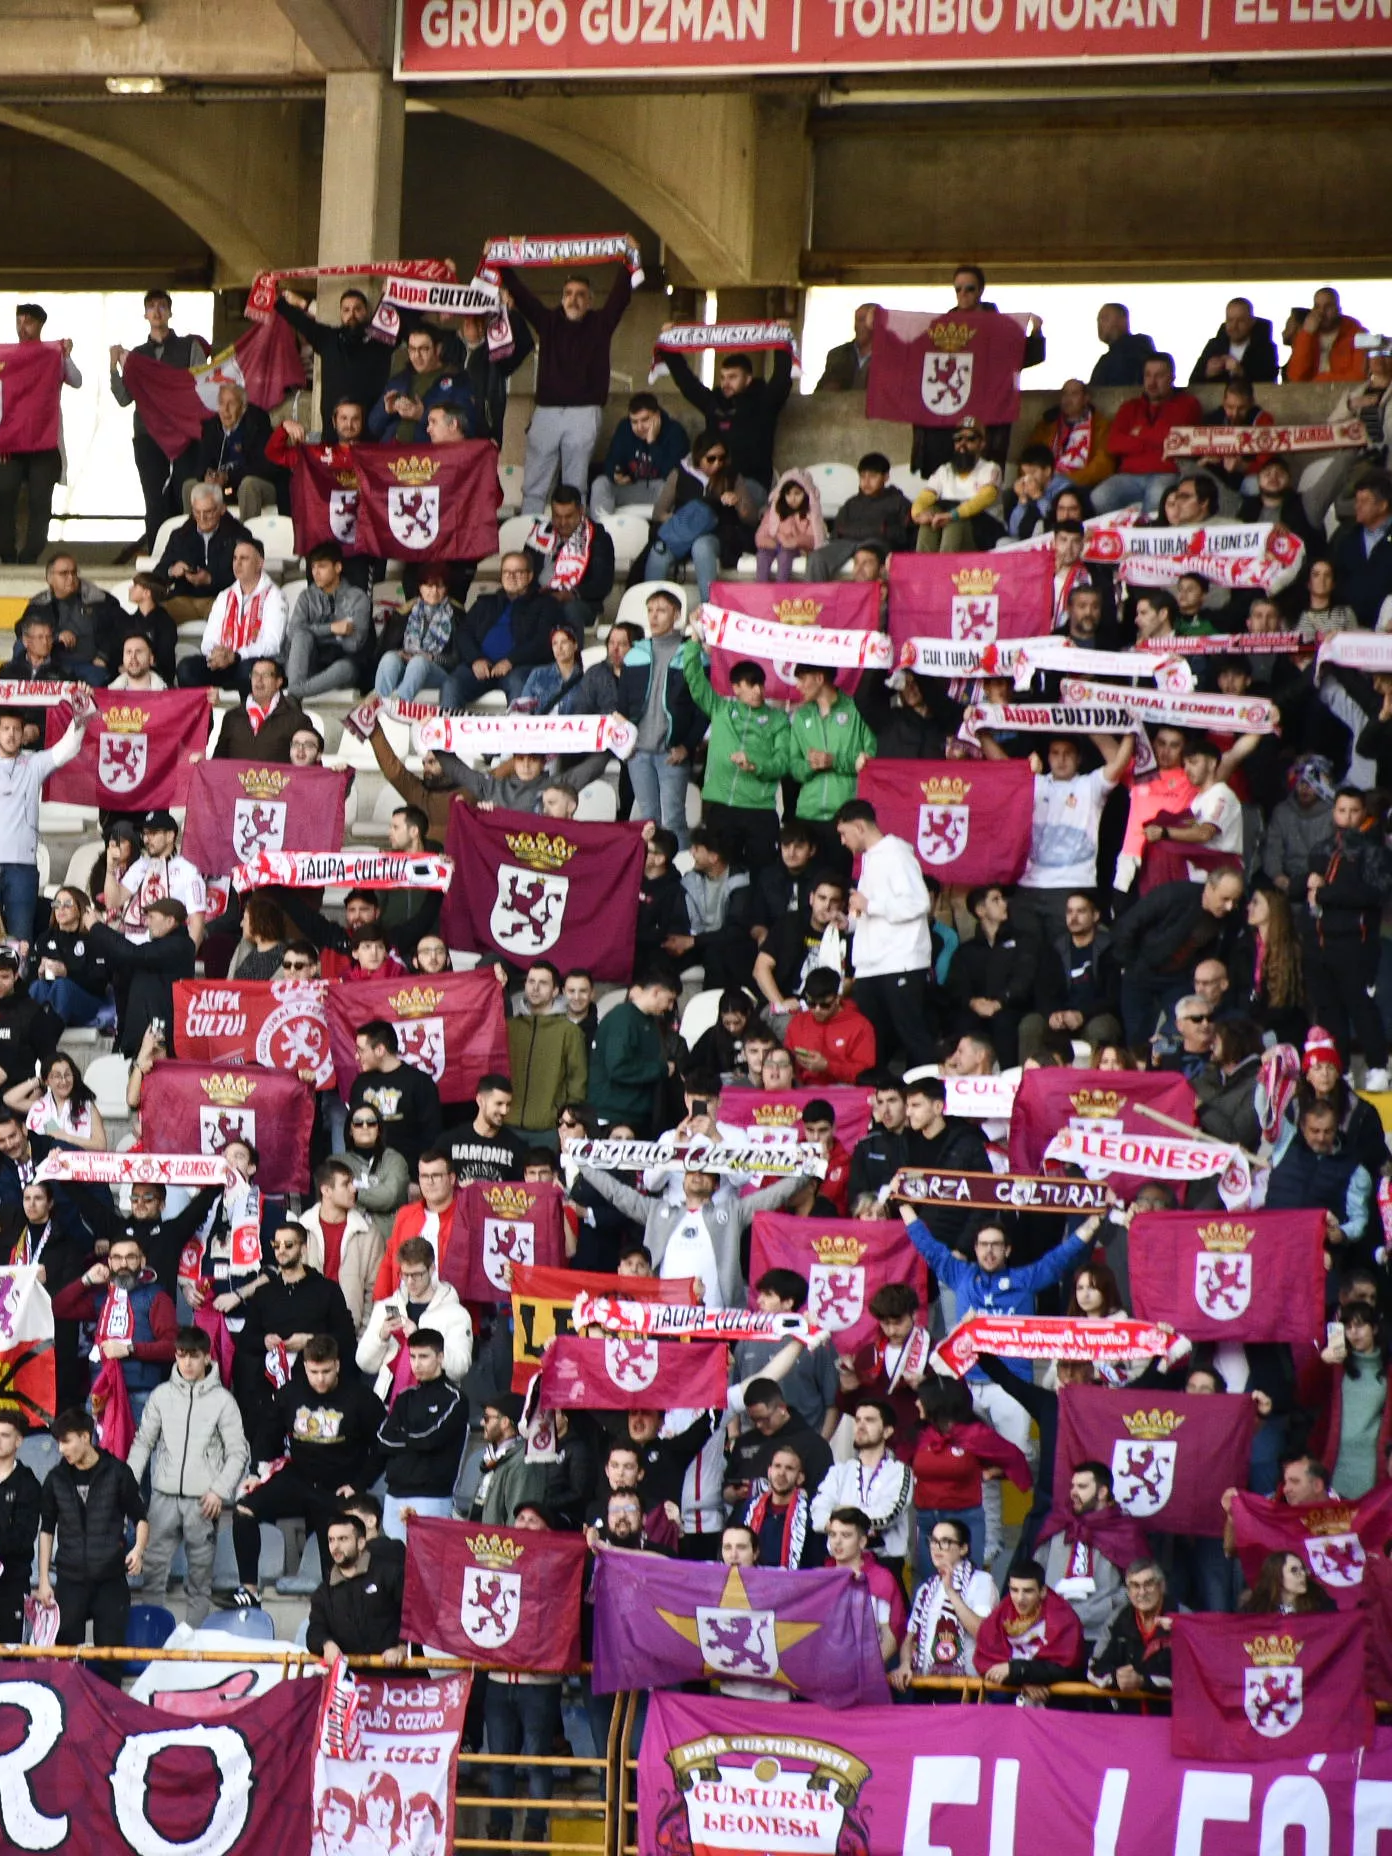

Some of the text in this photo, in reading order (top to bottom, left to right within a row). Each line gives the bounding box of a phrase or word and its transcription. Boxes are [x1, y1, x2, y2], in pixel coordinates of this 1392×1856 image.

[421, 0, 567, 48] GRUPO
[828, 0, 1003, 38] TORIBIO
[1130, 531, 1259, 555] CULTURAL LEONESA
[735, 618, 854, 647] CULTURAL
[1096, 690, 1166, 711] CULTURAL
[1170, 701, 1236, 718] LEONESA
[459, 718, 590, 734] CULTURAL
[451, 1143, 514, 1166] RAMONES
[382, 1681, 441, 1708] lads
[395, 1710, 445, 1731] cazurro
[383, 1745, 441, 1765] 1923
[683, 1736, 727, 1761] PEÑA
[693, 1784, 834, 1812] CULTURAL
[703, 1812, 821, 1839] LEONESA
